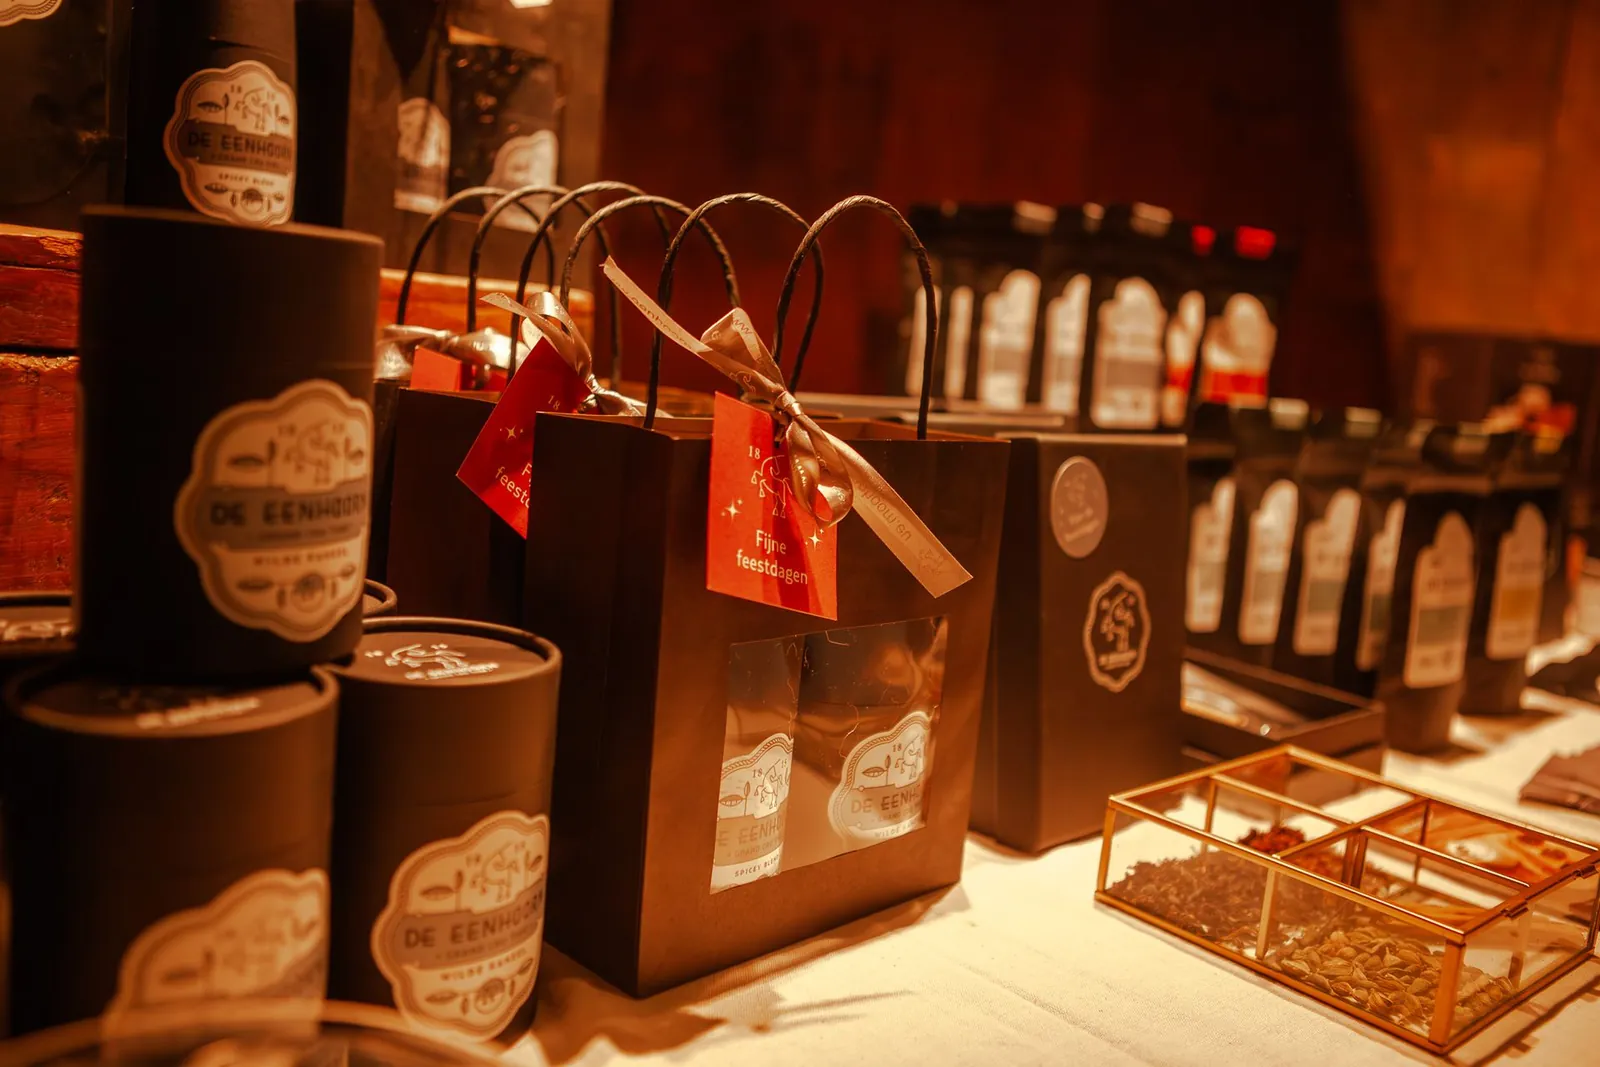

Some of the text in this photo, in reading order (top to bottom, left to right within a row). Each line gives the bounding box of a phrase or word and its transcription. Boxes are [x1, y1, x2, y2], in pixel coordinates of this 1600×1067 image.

[188, 131, 212, 148] DE
[748, 445, 761, 460] 18
[210, 501, 246, 526] DE
[755, 529, 787, 555] Fijne
[736, 549, 808, 585] feestdagen
[752, 768, 763, 779] 18
[851, 798, 873, 814] DE
[405, 926, 437, 949] DE
